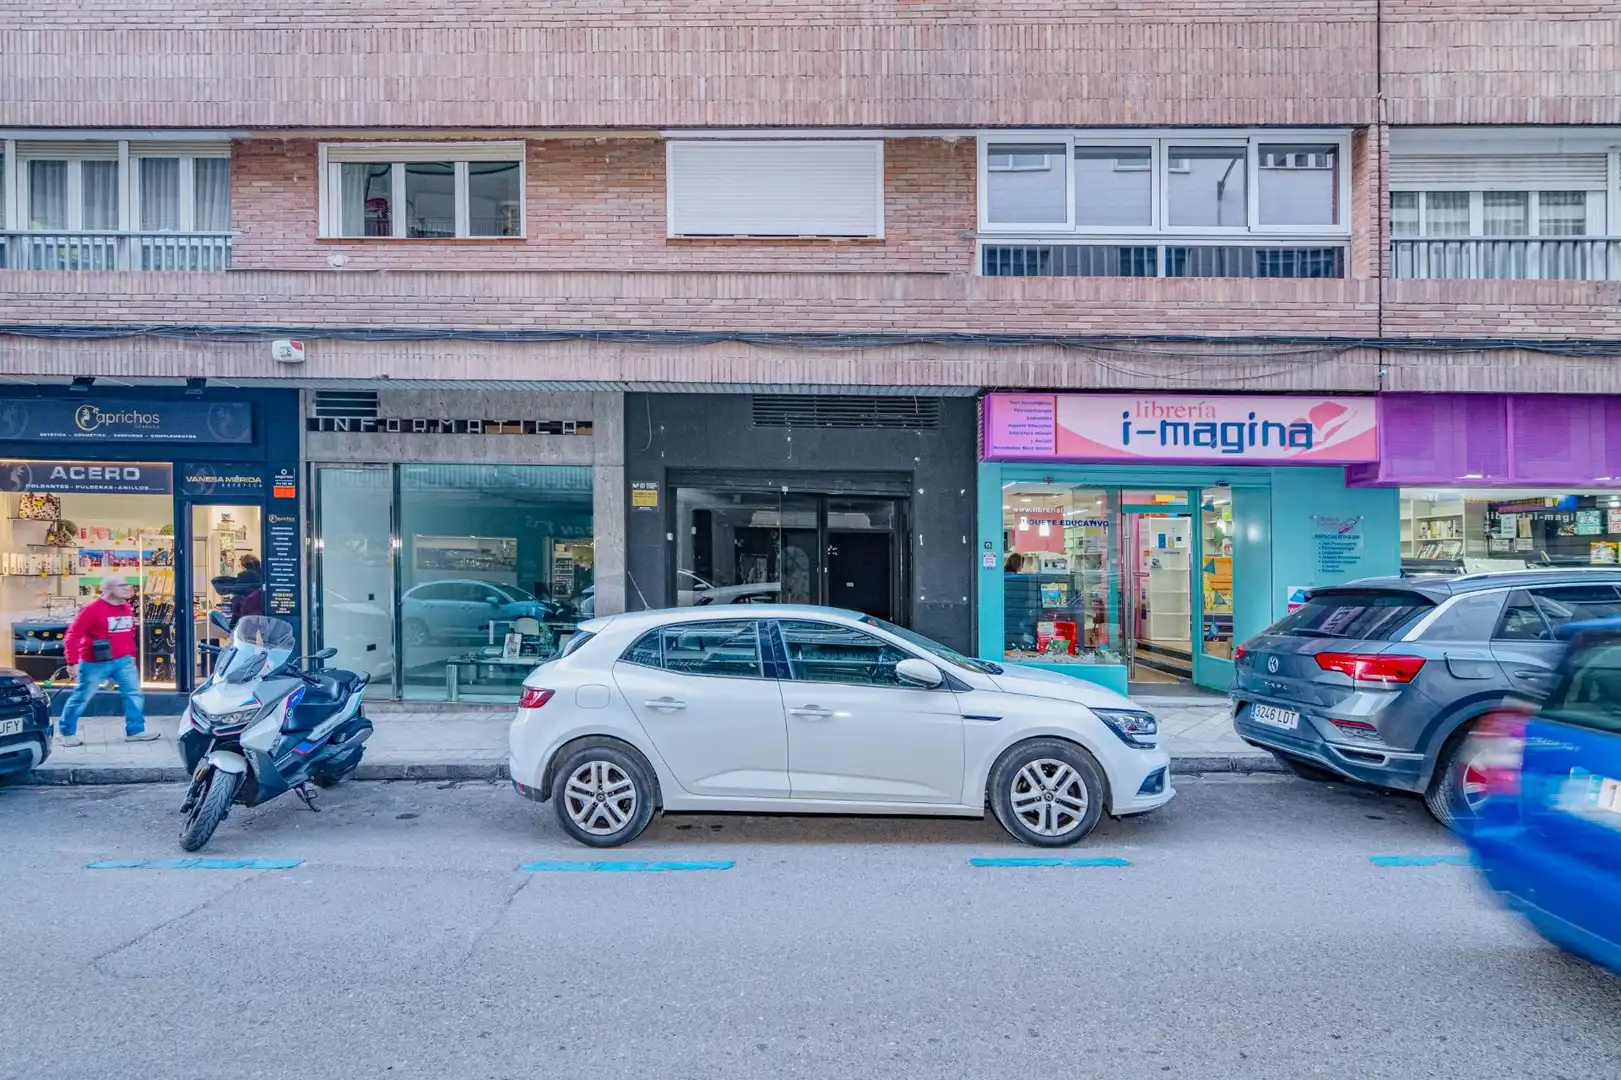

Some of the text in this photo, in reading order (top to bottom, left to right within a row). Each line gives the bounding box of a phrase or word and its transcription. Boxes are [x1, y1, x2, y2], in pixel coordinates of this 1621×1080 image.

[1135, 400, 1217, 420] librería
[1122, 411, 1314, 454] i-magina
[50, 466, 140, 480] ACERO
[225, 474, 262, 483] MÉRIDA
[1059, 519, 1109, 527] EDUCATIVO
[1256, 705, 1297, 725] 3246 LDT
